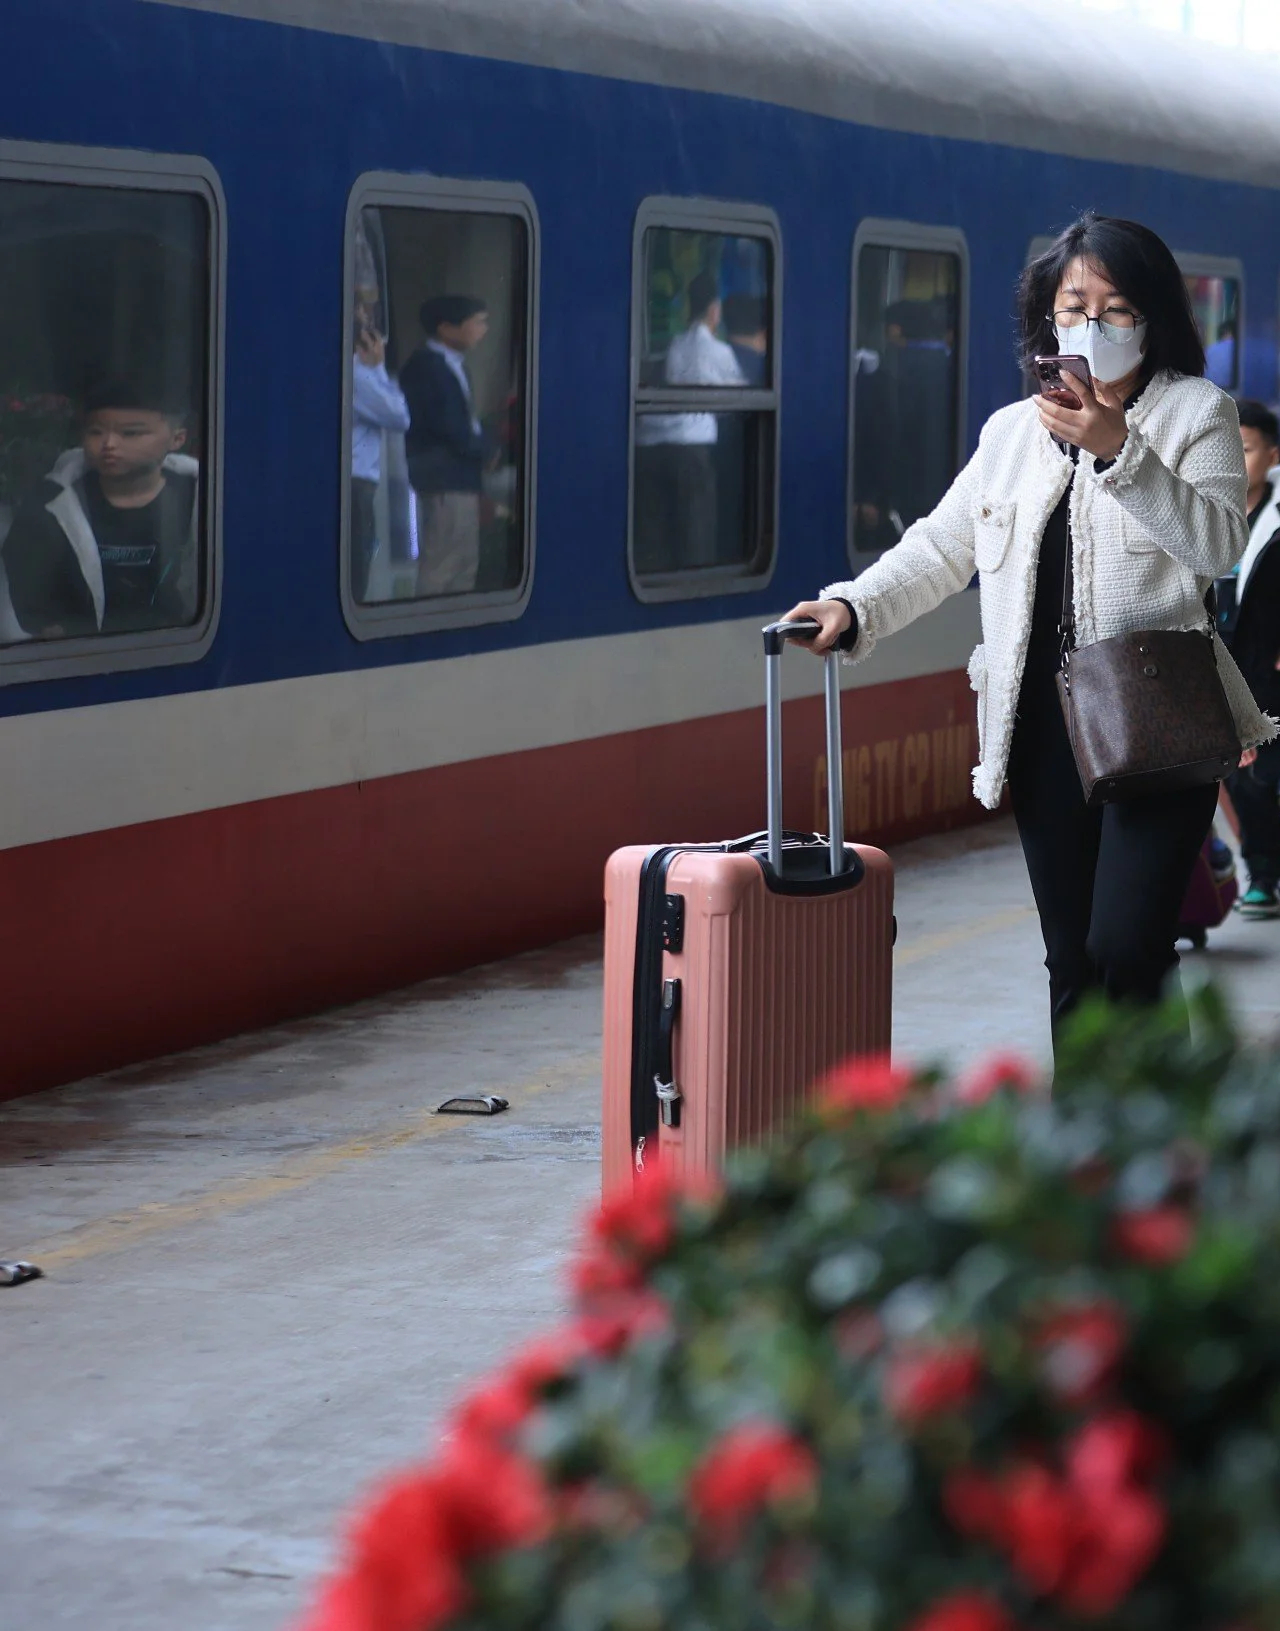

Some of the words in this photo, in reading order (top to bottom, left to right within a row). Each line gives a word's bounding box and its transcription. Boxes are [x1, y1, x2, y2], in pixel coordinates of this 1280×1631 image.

[814, 744, 871, 834] CNG
[875, 737, 899, 828] TY
[904, 731, 930, 820] CP
